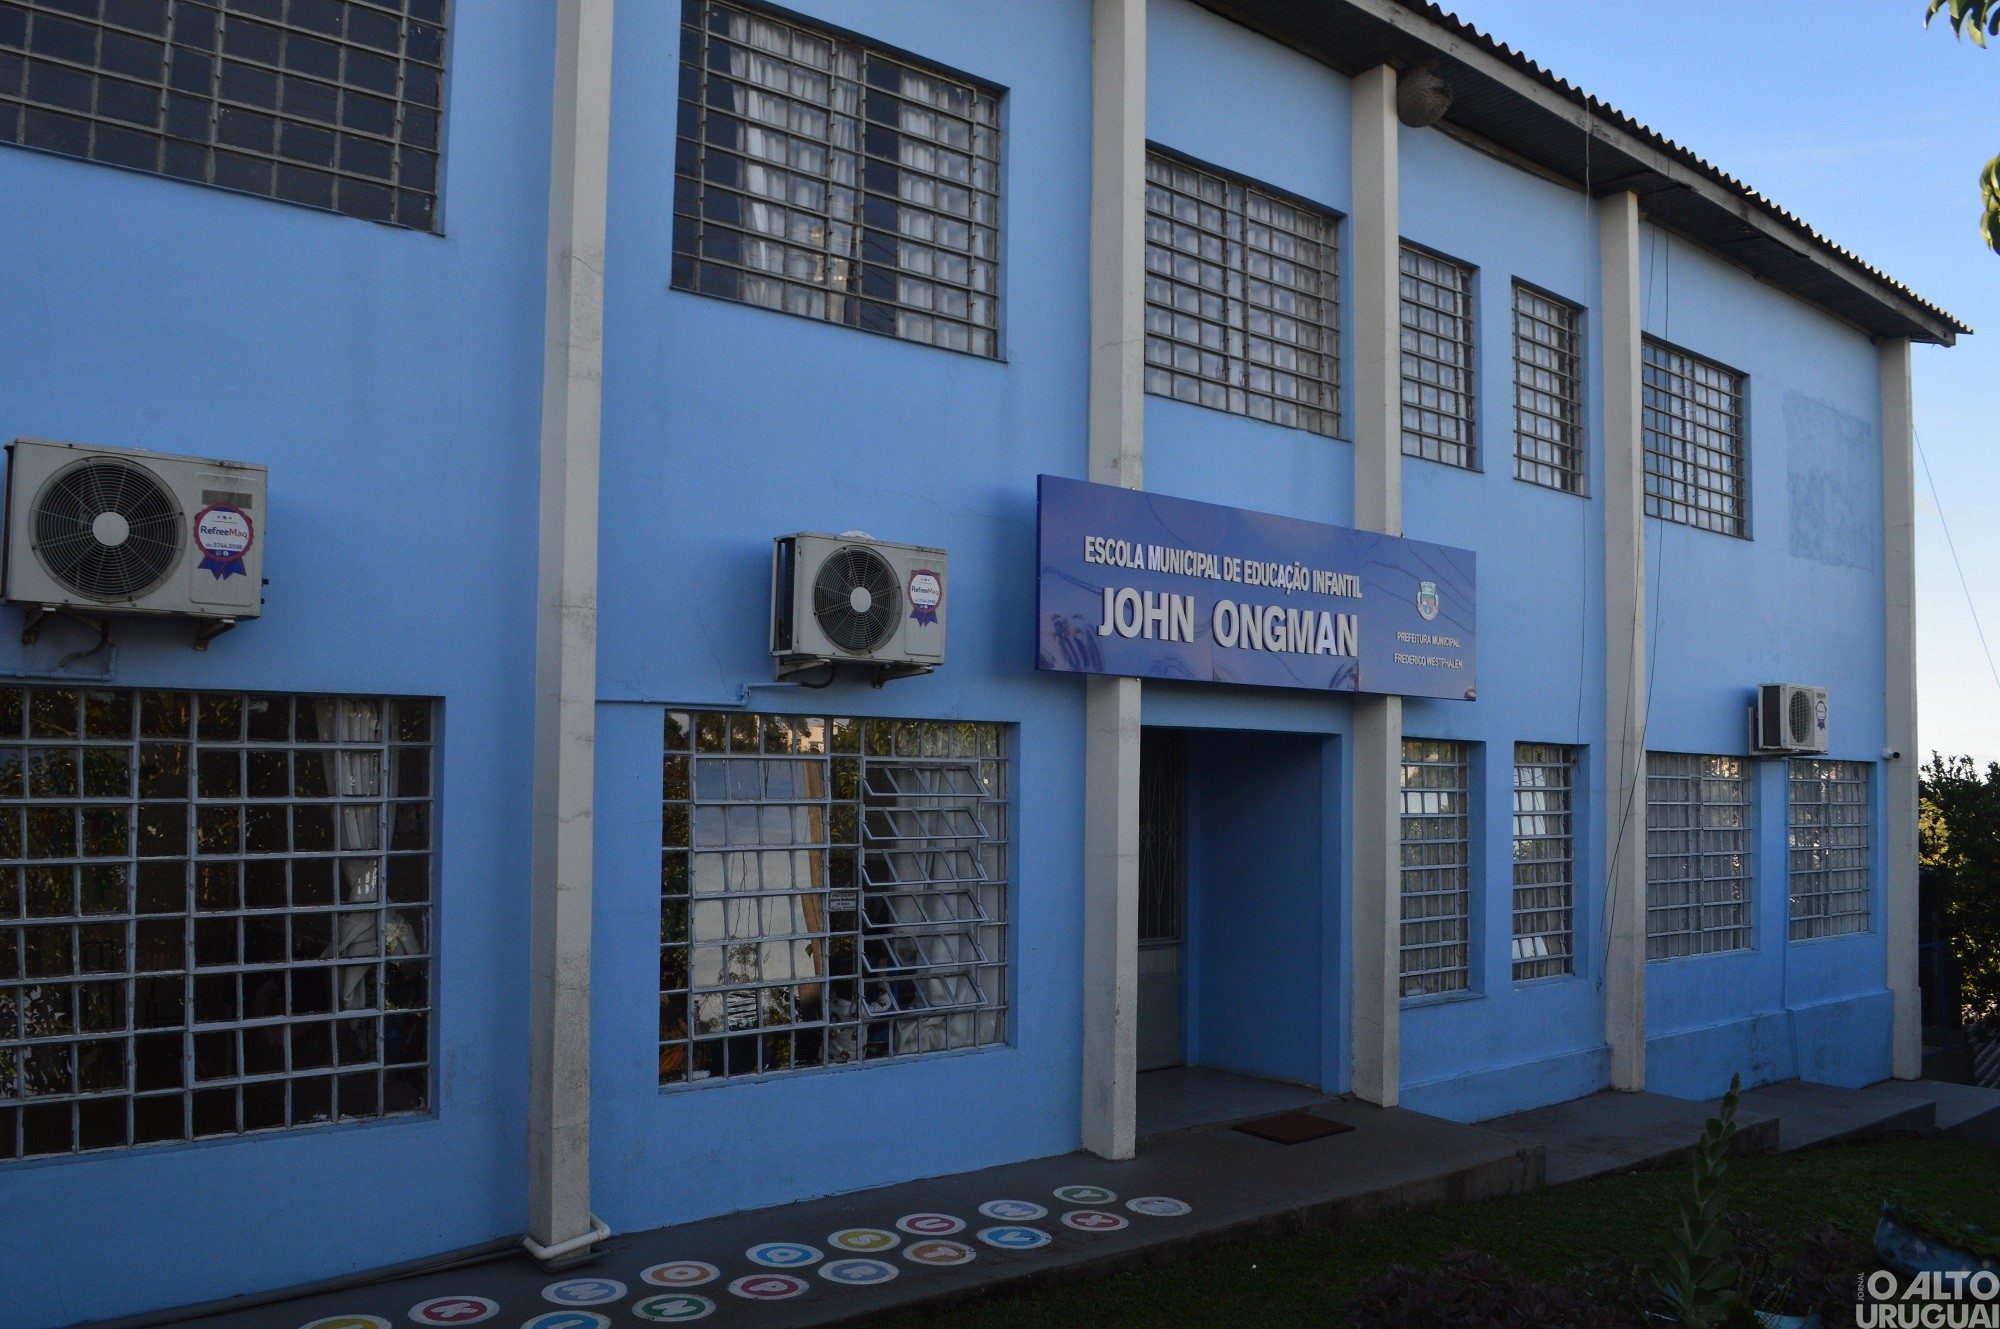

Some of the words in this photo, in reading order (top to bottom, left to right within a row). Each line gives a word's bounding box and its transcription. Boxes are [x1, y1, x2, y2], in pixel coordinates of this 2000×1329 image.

[1084, 535, 1145, 570] ESCOLA
[1147, 544, 1221, 580] MUNICIPAL
[1222, 556, 1241, 583] DE
[1243, 560, 1310, 595] EDUCAÇÃO
[1311, 569, 1363, 599] INFANTIL
[1098, 587, 1195, 643] JOHN
[1212, 599, 1358, 657] ONGMAN
[1396, 631, 1431, 645] PREFEITURA
[1431, 635, 1460, 648] MUNICIPAL
[1394, 652, 1427, 666] FREDERICO
[1427, 656, 1463, 669] WESTPHALEN
